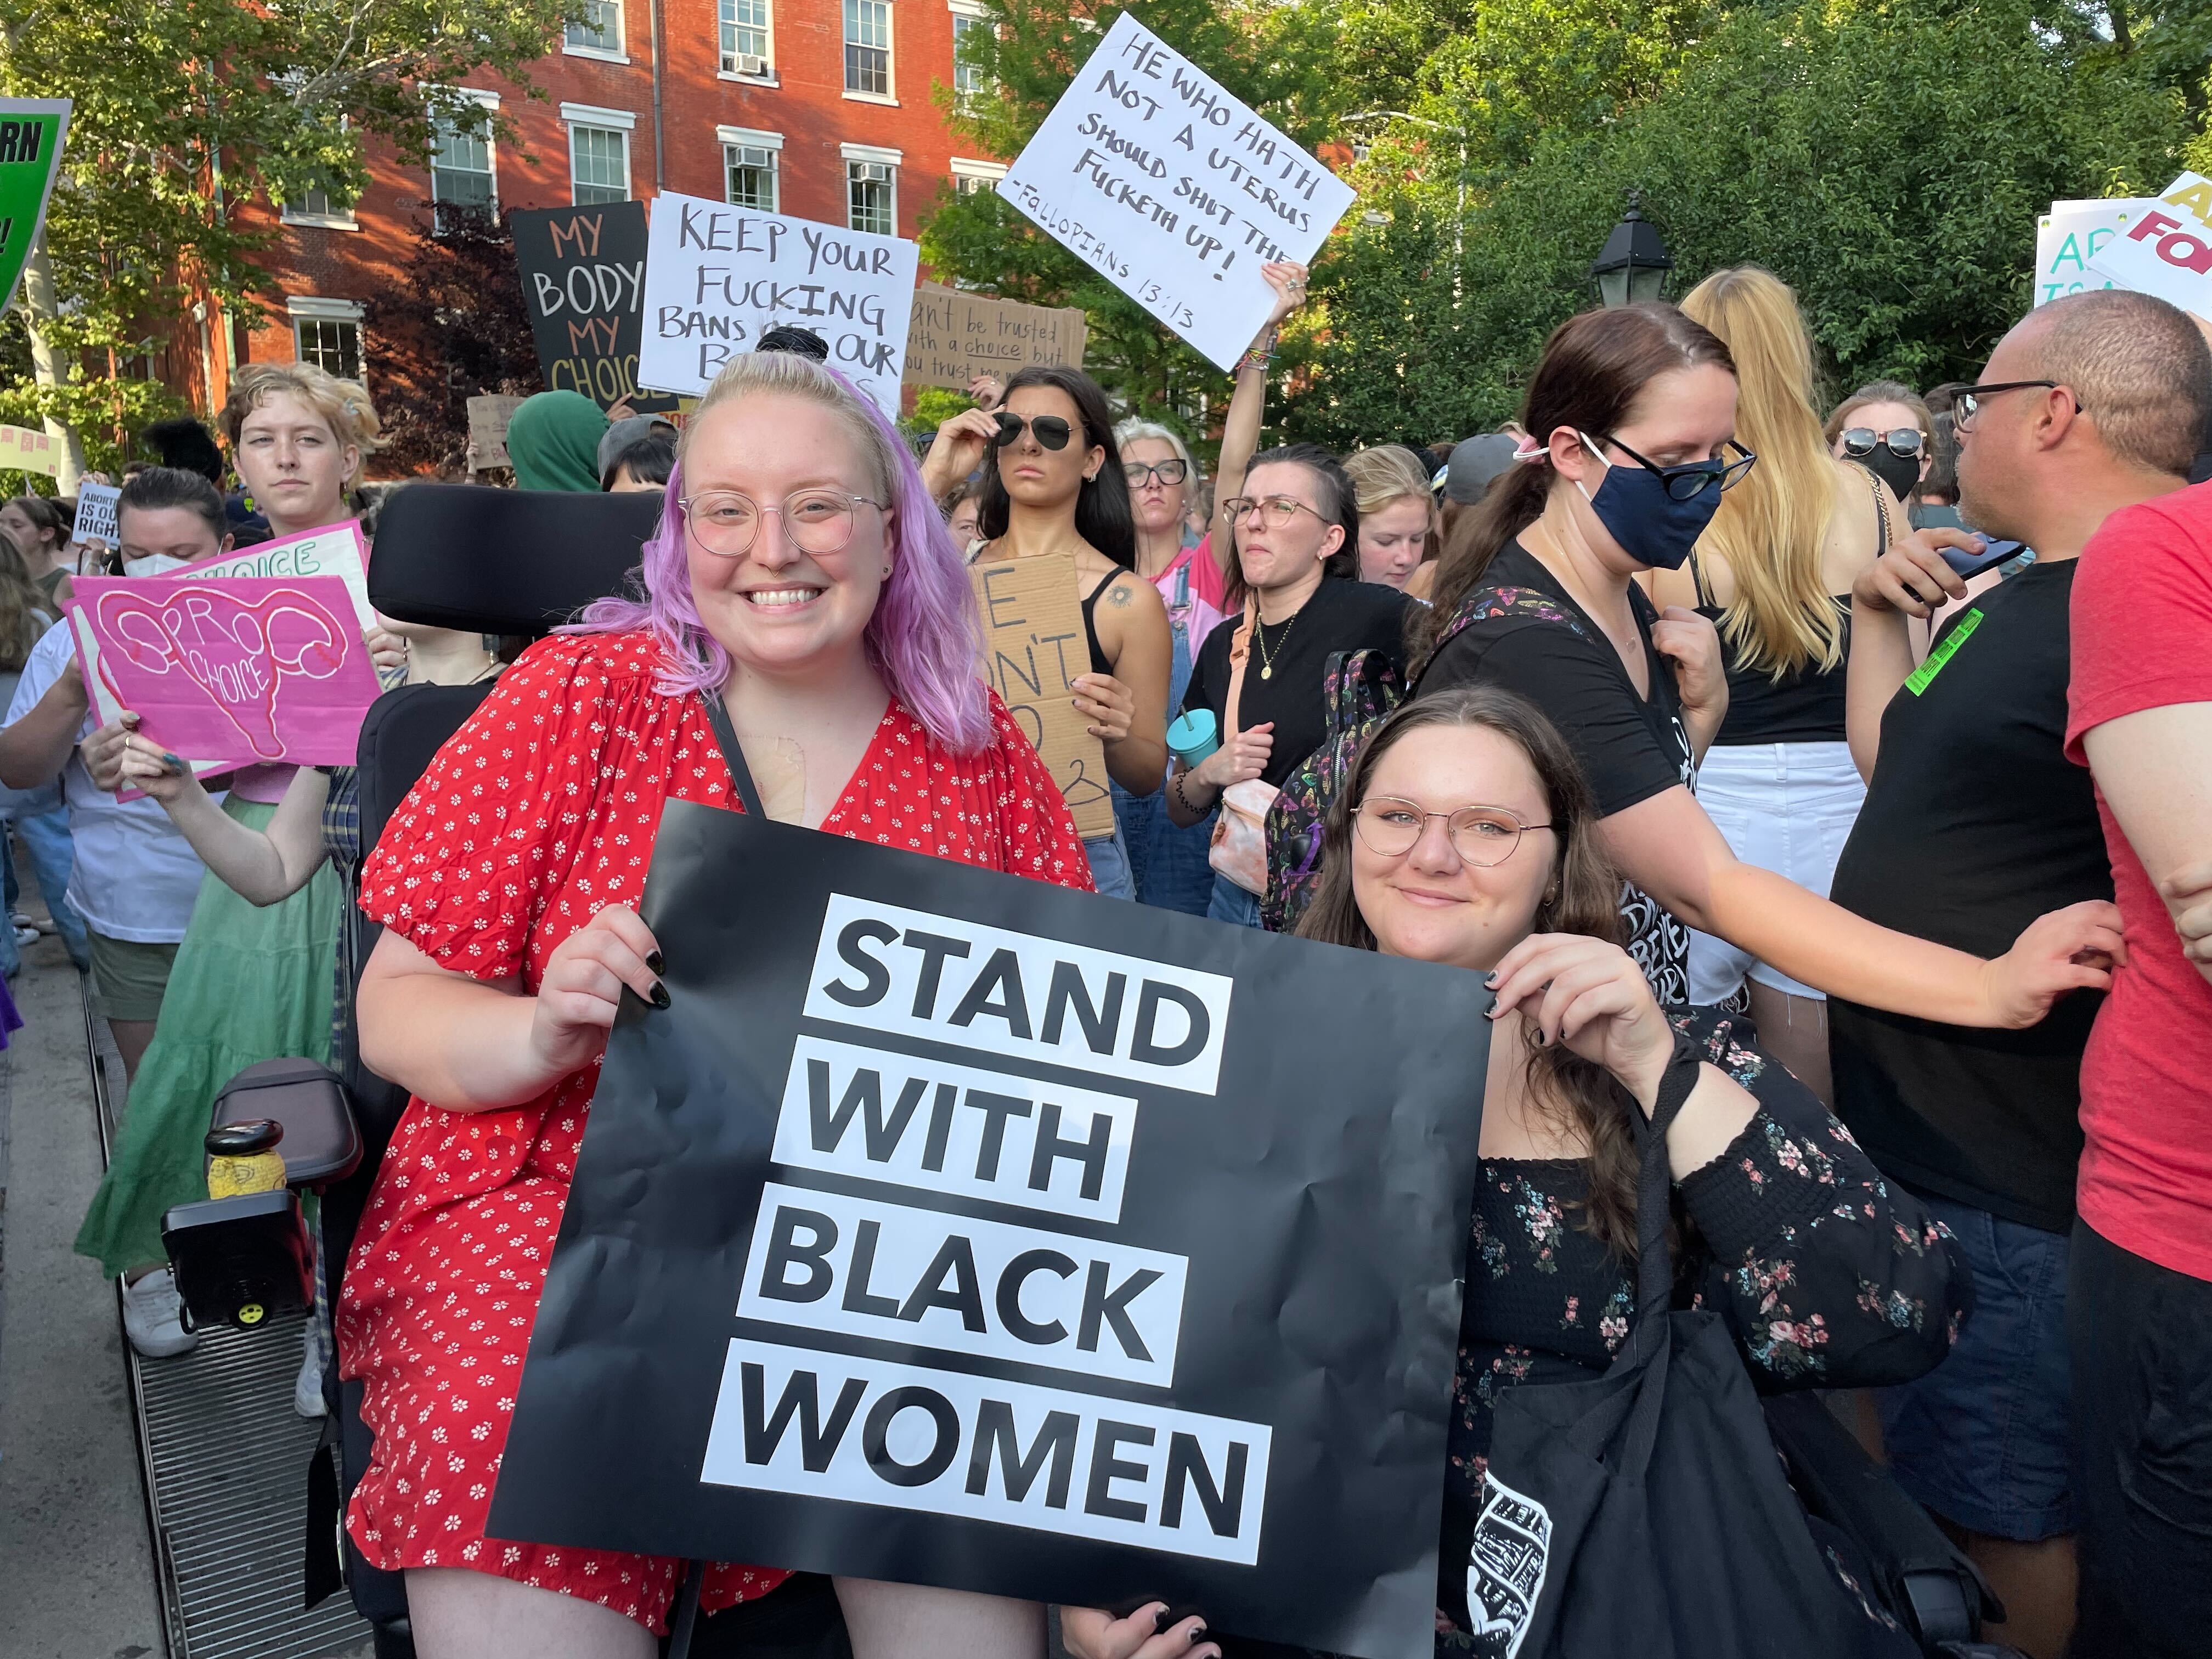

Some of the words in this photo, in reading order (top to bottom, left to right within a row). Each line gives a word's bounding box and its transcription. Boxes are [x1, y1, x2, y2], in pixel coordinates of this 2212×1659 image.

[1121, 33, 1171, 80] HE
[1172, 67, 1231, 126] WHO
[1234, 122, 1320, 201] HATH
[1077, 113, 1167, 178] SHOULD
[1173, 177, 1235, 225] SHUT
[1095, 70, 1164, 120] NOT
[1173, 124, 1194, 151] A
[1208, 148, 1311, 233] UTERUS
[549, 213, 602, 258] MY
[680, 203, 787, 262] KEEP
[802, 227, 895, 275] YOUR
[1073, 149, 1179, 233] FUCKETH
[1186, 225, 1235, 281] UP!
[533, 261, 643, 317] BODY
[696, 264, 884, 336] FUCKING
[1138, 279, 1193, 328] 13:13
[567, 316, 619, 356] MY
[659, 306, 746, 341] BANS
[967, 307, 987, 333] be
[996, 311, 1057, 343] trusted
[551, 354, 671, 402] CHOIC
[836, 334, 898, 377] OUR
[932, 357, 972, 383] trust
[949, 340, 957, 352] a
[965, 338, 1020, 357] choice
[1033, 346, 1063, 366] but
[81, 503, 94, 517] IS
[162, 598, 264, 656] PRO
[190, 649, 269, 703] CHOICE
[822, 918, 1211, 1066] STAND
[806, 1057, 1113, 1201] WITH
[758, 1204, 1165, 1363] BLACK
[740, 1361, 1249, 1539] WOMEN
